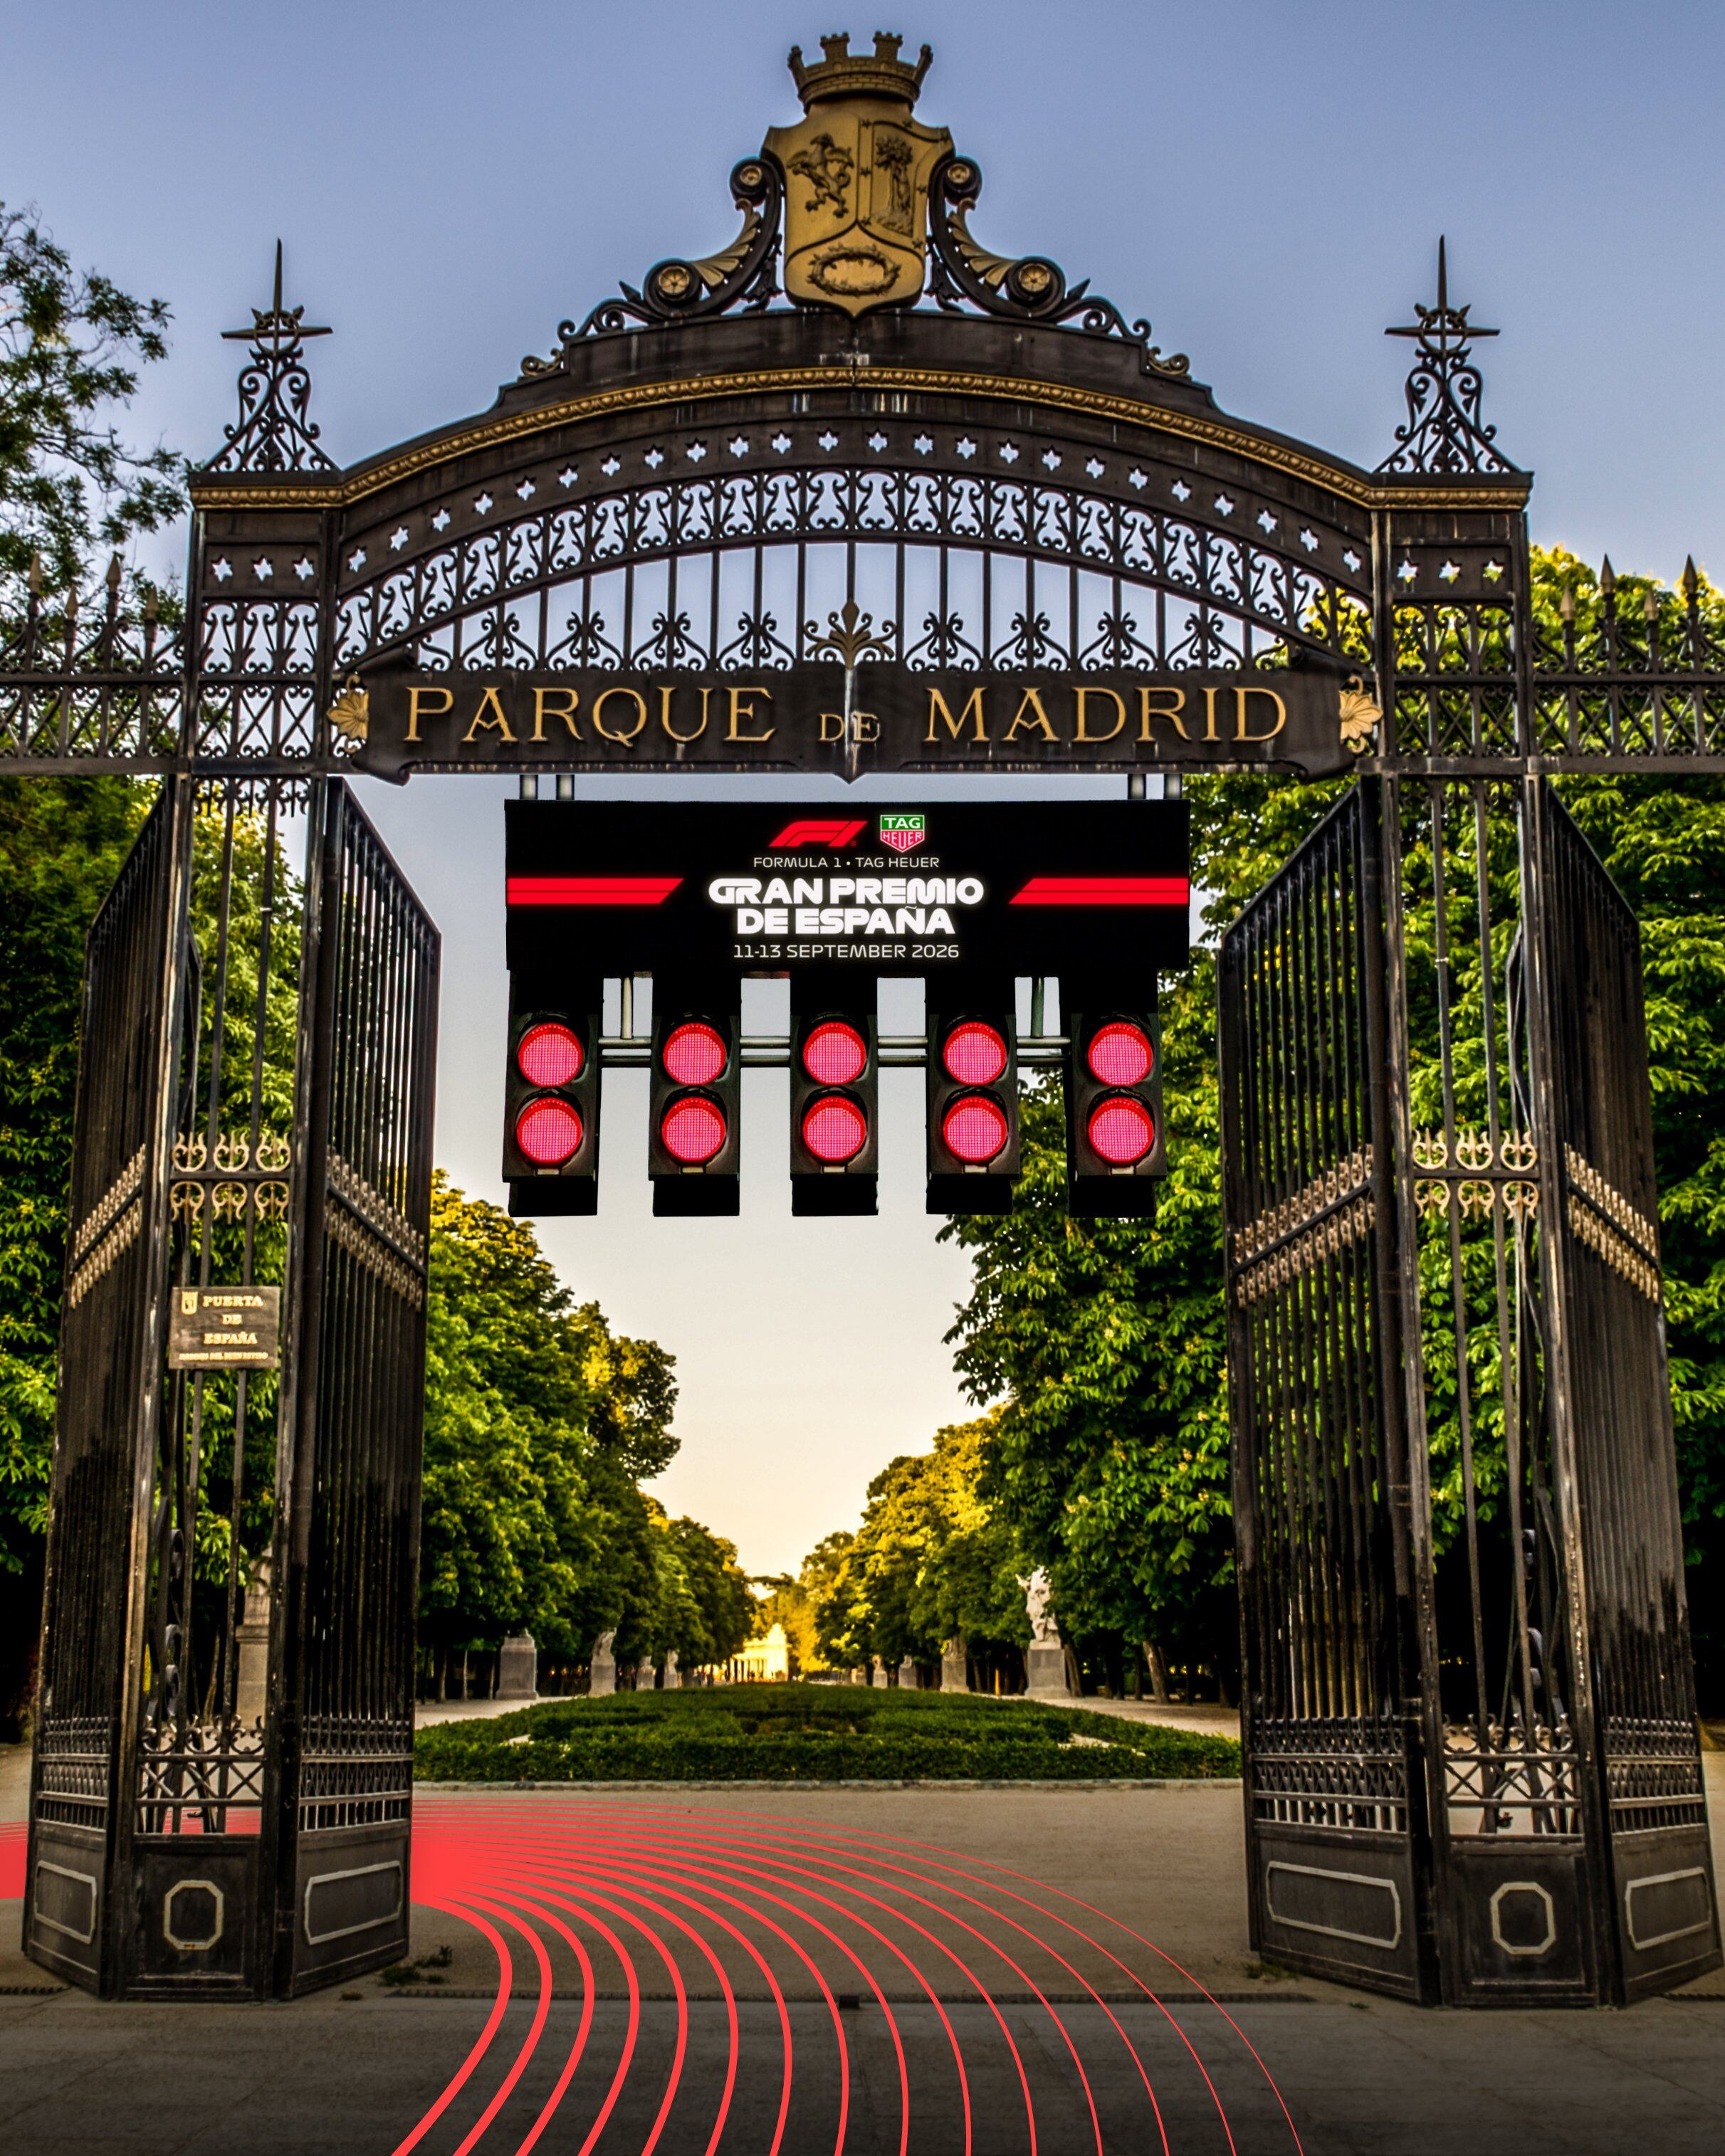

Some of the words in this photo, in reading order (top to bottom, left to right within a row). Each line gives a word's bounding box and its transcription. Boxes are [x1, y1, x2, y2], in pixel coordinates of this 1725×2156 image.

[405, 687, 775, 748] PARQUE
[820, 712, 879, 743] DE
[926, 687, 1287, 743] MADRID
[884, 817, 921, 829] TAG
[883, 831, 923, 848] HEUER
[753, 857, 828, 868] FORMULA
[834, 857, 841, 868] 1
[855, 857, 884, 868] TAG
[888, 857, 940, 868] HEUER
[708, 877, 823, 905] GRAN
[829, 877, 985, 905] PREMIO
[737, 908, 789, 935] DE
[795, 905, 956, 935] ESPAÑA
[734, 945, 781, 958] 11-13
[787, 945, 906, 958] SEPTEMBER
[911, 945, 959, 958] 2026
[203, 1295, 264, 1308] PUERTA
[222, 1314, 242, 1325] DE
[204, 1331, 258, 1345] ESPAÑA
